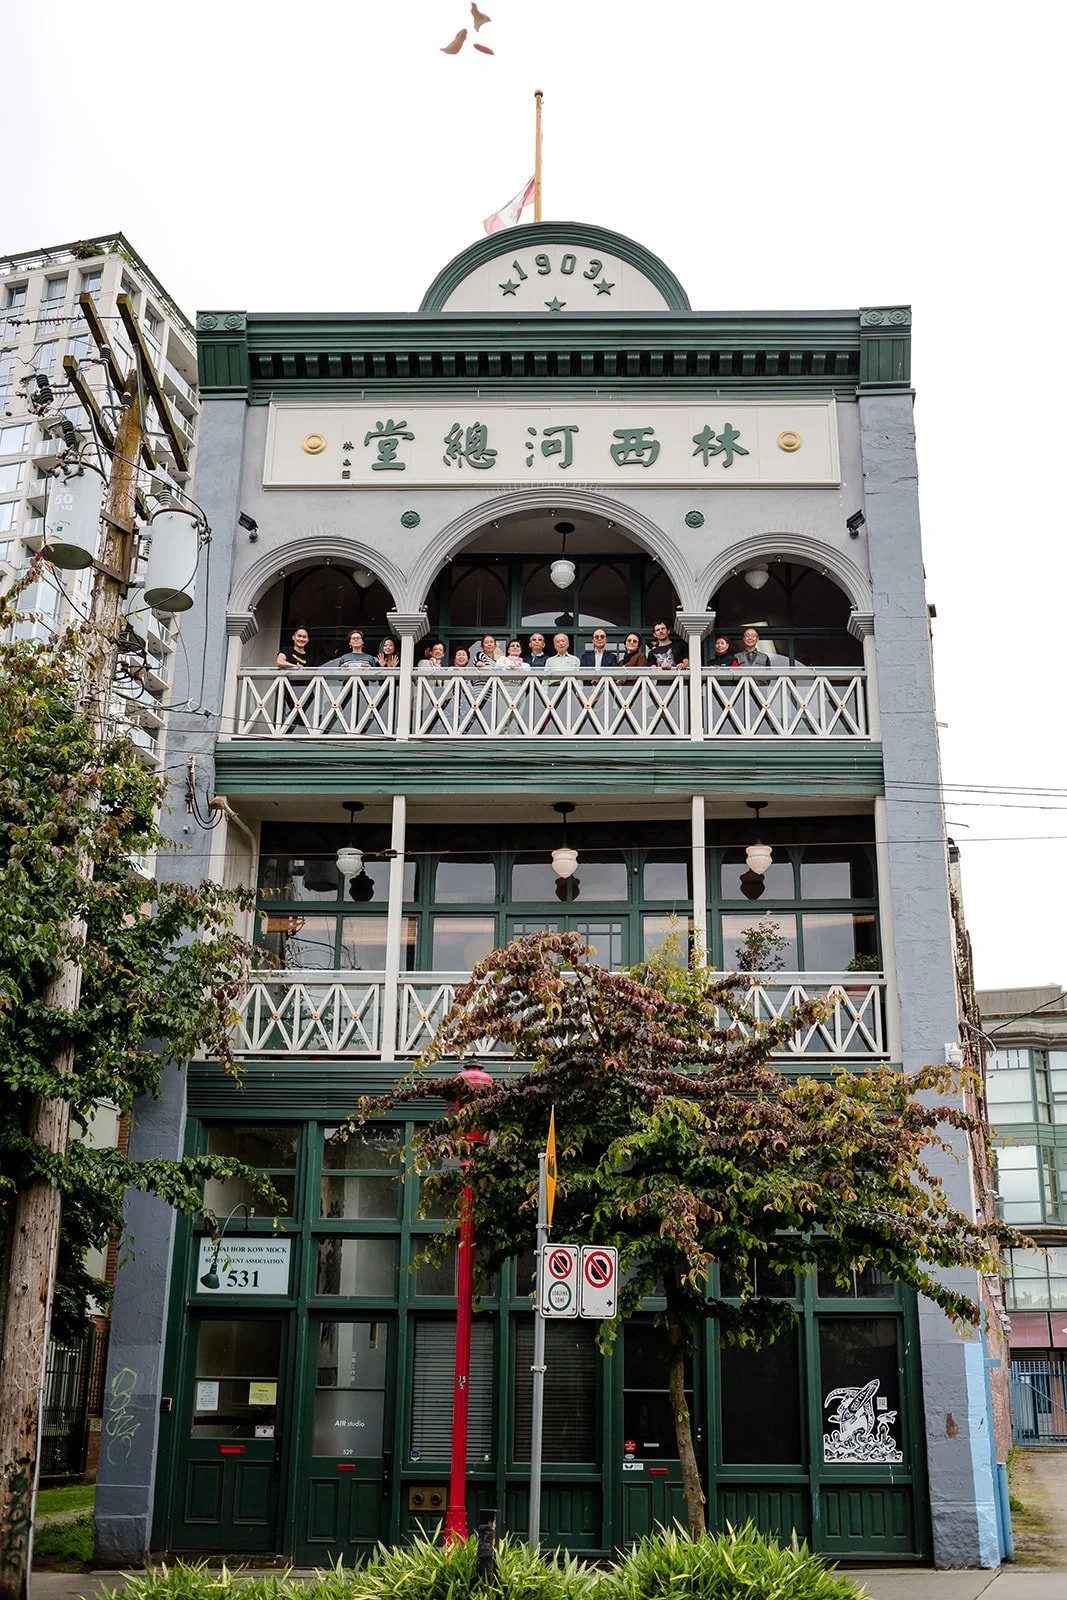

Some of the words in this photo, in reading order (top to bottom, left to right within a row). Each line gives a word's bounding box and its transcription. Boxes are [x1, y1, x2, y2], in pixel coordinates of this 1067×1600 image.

[512, 253, 603, 281] 1903
[54, 493, 73, 505] 50
[265, 1246, 287, 1254] MOCK
[226, 1269, 259, 1288] 531
[347, 1420, 365, 1428] studio
